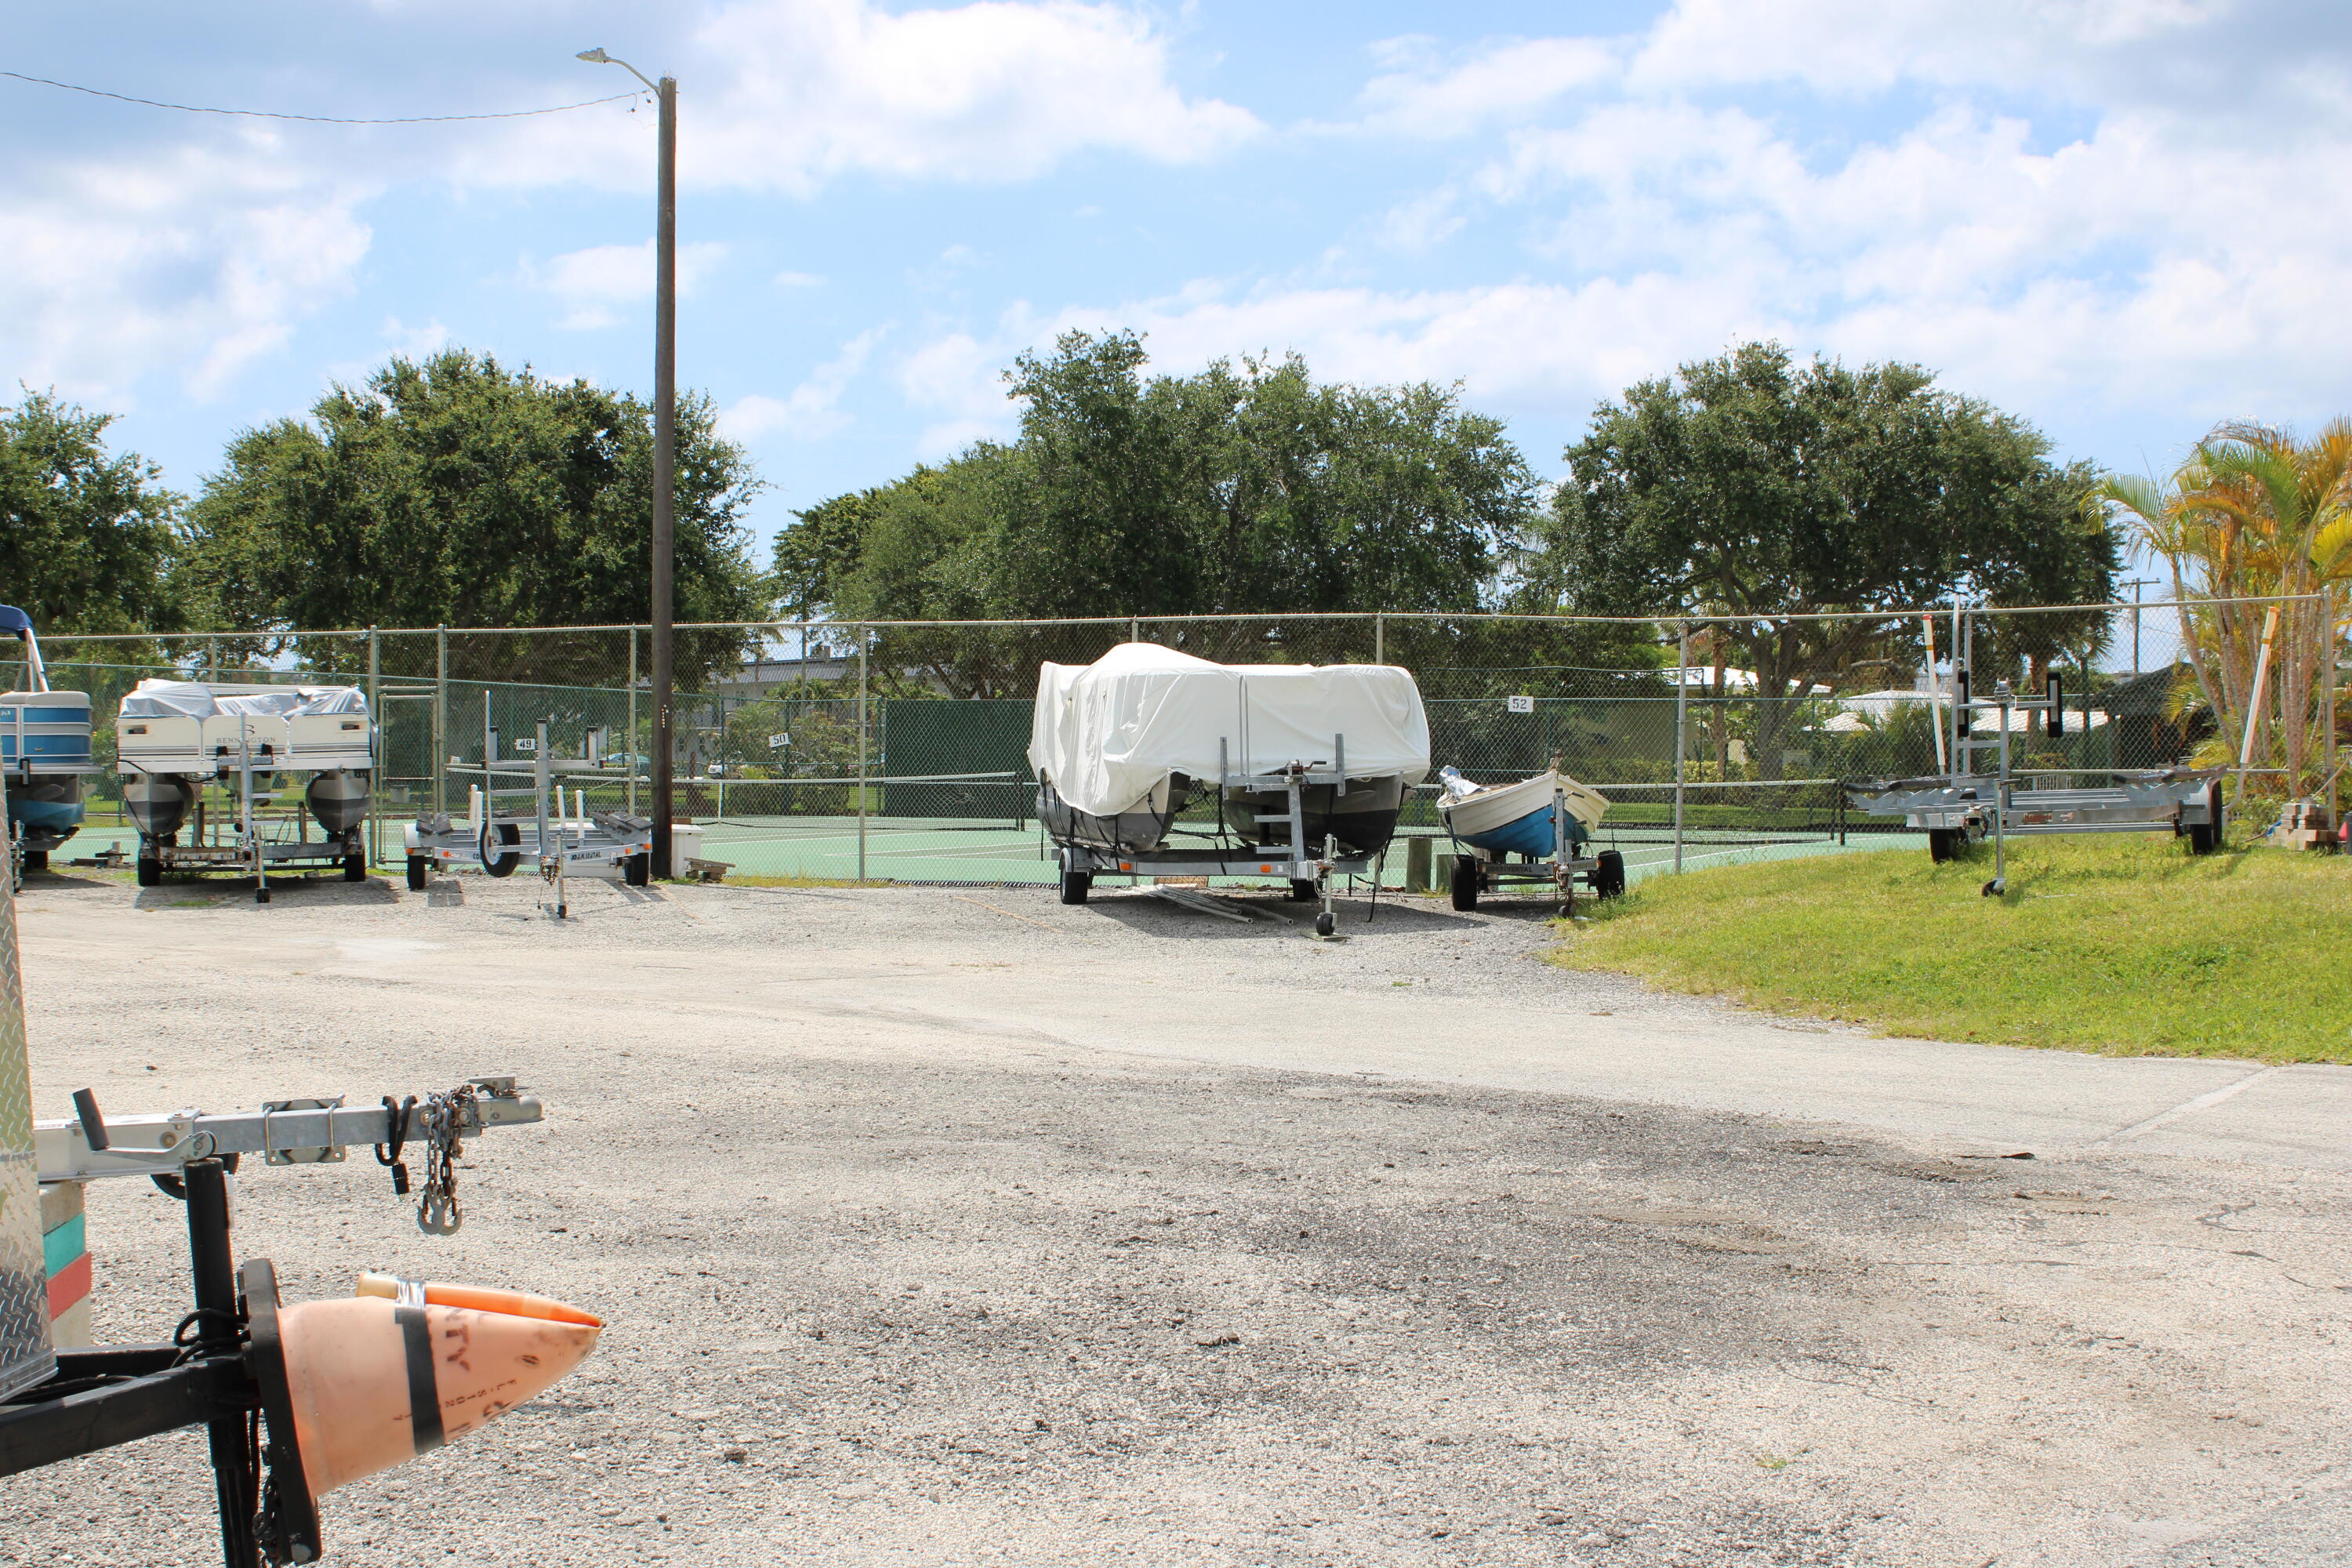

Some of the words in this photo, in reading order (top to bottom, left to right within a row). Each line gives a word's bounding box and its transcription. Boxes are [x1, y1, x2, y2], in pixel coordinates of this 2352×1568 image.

[1512, 698, 1527, 710] 52
[518, 739, 532, 749] 49
[773, 734, 786, 745] 50
